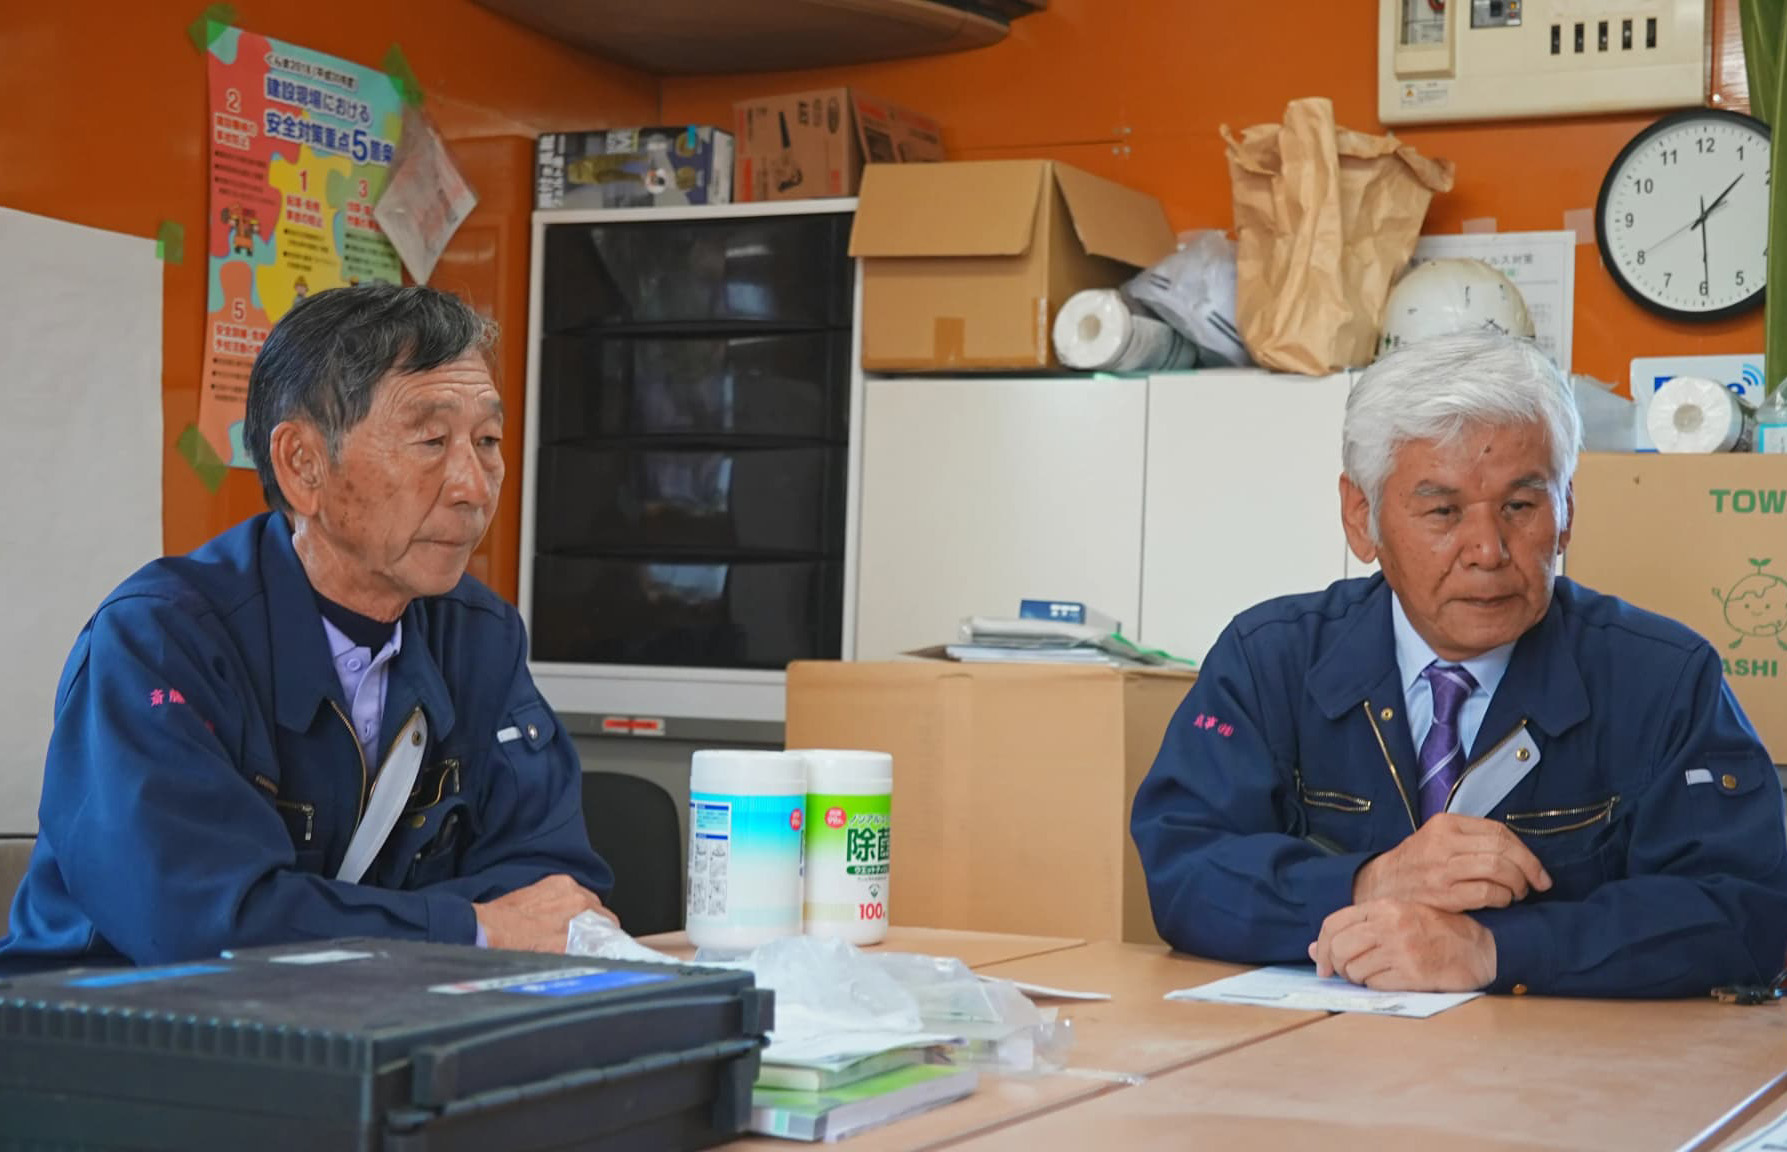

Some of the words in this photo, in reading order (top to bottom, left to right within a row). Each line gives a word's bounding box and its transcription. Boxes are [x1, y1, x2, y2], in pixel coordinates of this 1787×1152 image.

[227, 91, 240, 111] 2
[1695, 138, 1715, 153] 12
[1736, 146, 1743, 160] 1
[1660, 150, 1677, 165] 11
[299, 170, 307, 192] 1
[1635, 179, 1653, 194] 10
[359, 180, 368, 198] 3
[1625, 213, 1634, 228] 9
[1636, 250, 1645, 265] 8
[1663, 273, 1672, 287] 7
[1735, 271, 1744, 286] 5
[1699, 281, 1708, 295] 6
[234, 302, 244, 320] 5
[1709, 490, 1787, 513] TOW
[846, 827, 890, 863] 除菌
[859, 902, 886, 920] 100
